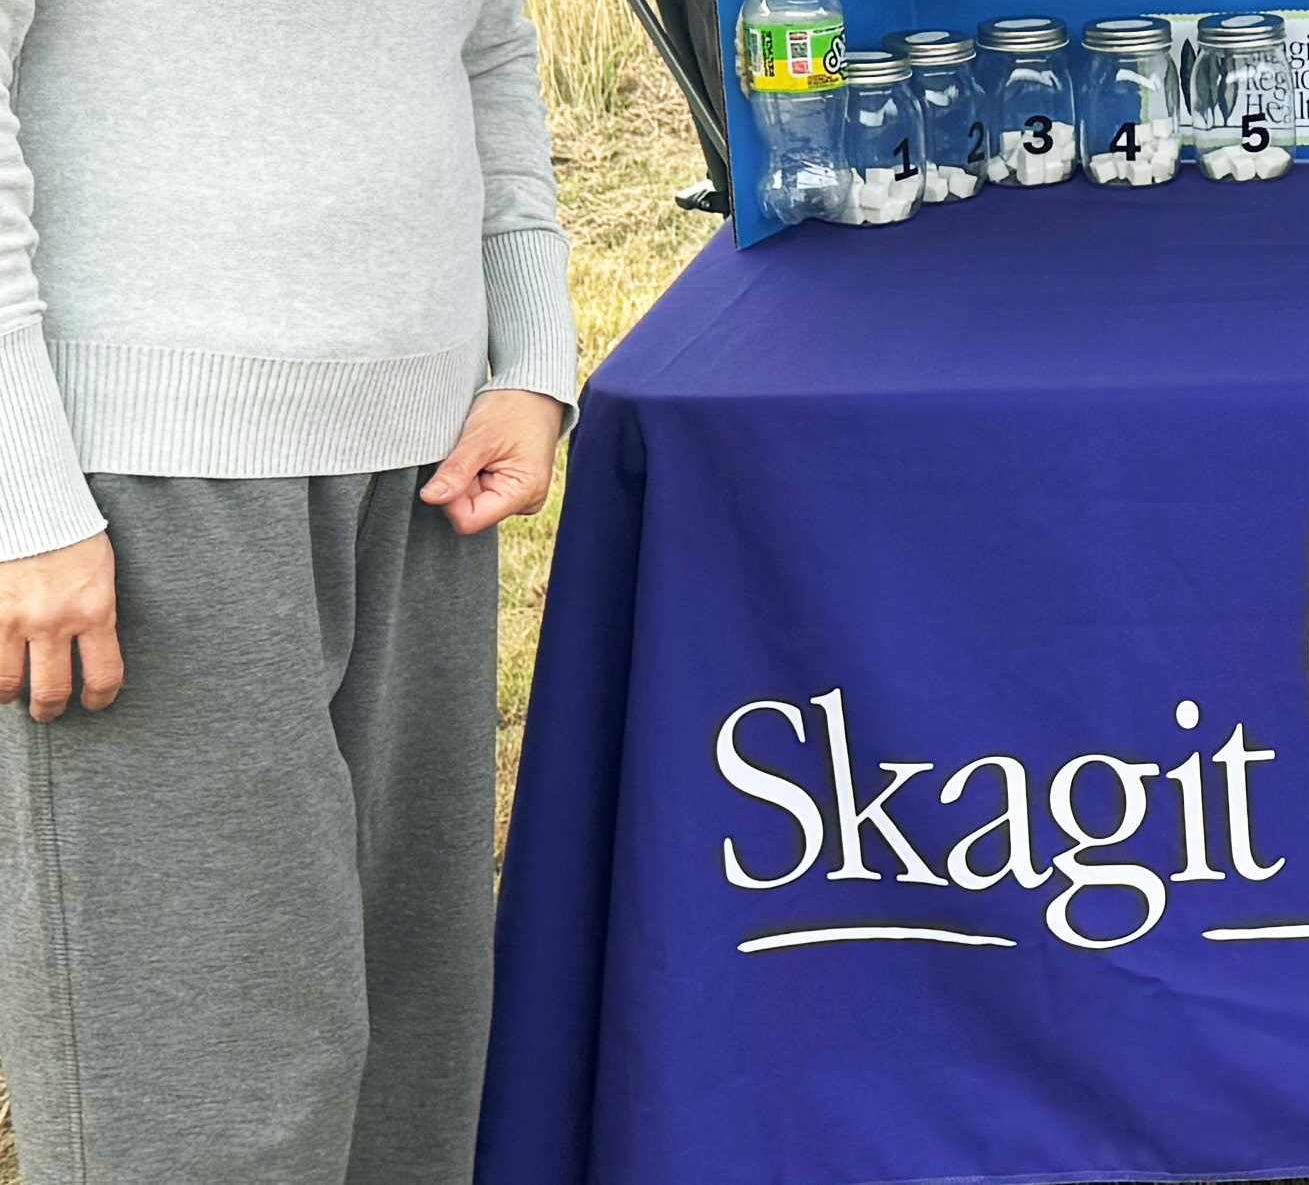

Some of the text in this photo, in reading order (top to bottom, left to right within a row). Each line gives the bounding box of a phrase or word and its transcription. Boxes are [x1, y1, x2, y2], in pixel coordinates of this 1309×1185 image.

[967, 121, 986, 164] 2
[1022, 115, 1053, 155] 3
[1110, 122, 1141, 161] 4
[1240, 113, 1270, 153] 5
[893, 138, 919, 181] 1
[714, 687, 1285, 949] Skagit
